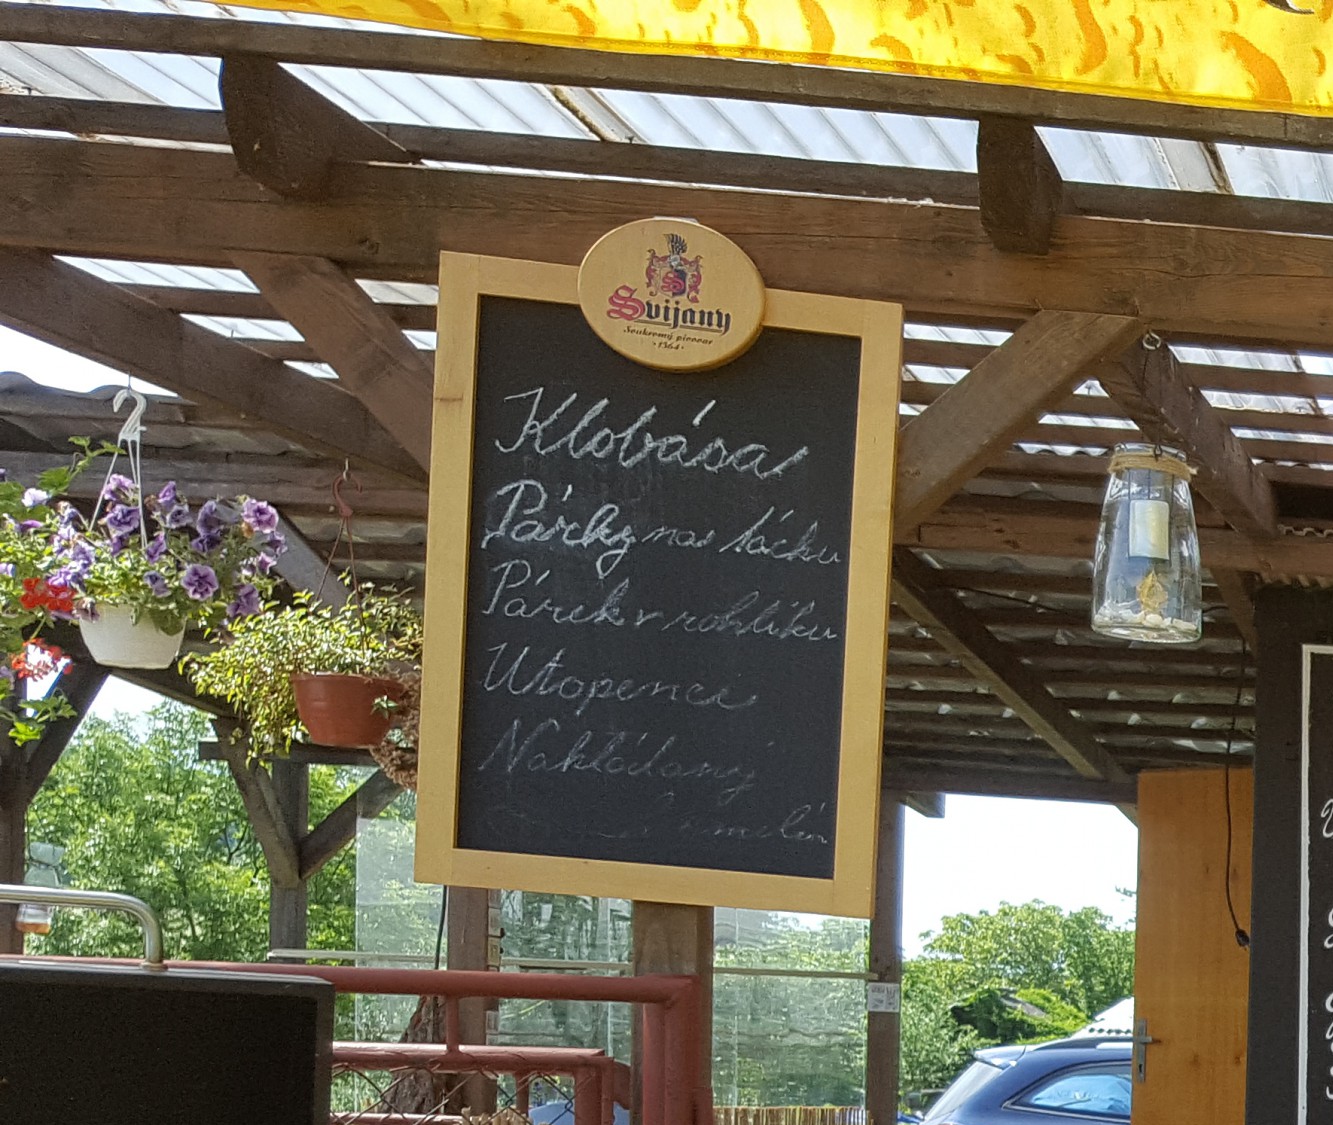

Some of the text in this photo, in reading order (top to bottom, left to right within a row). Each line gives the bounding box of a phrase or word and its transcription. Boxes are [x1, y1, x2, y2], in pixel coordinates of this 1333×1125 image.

[606, 284, 732, 337] Svijany
[495, 386, 809, 480] Klobása
[481, 478, 637, 579] Párky
